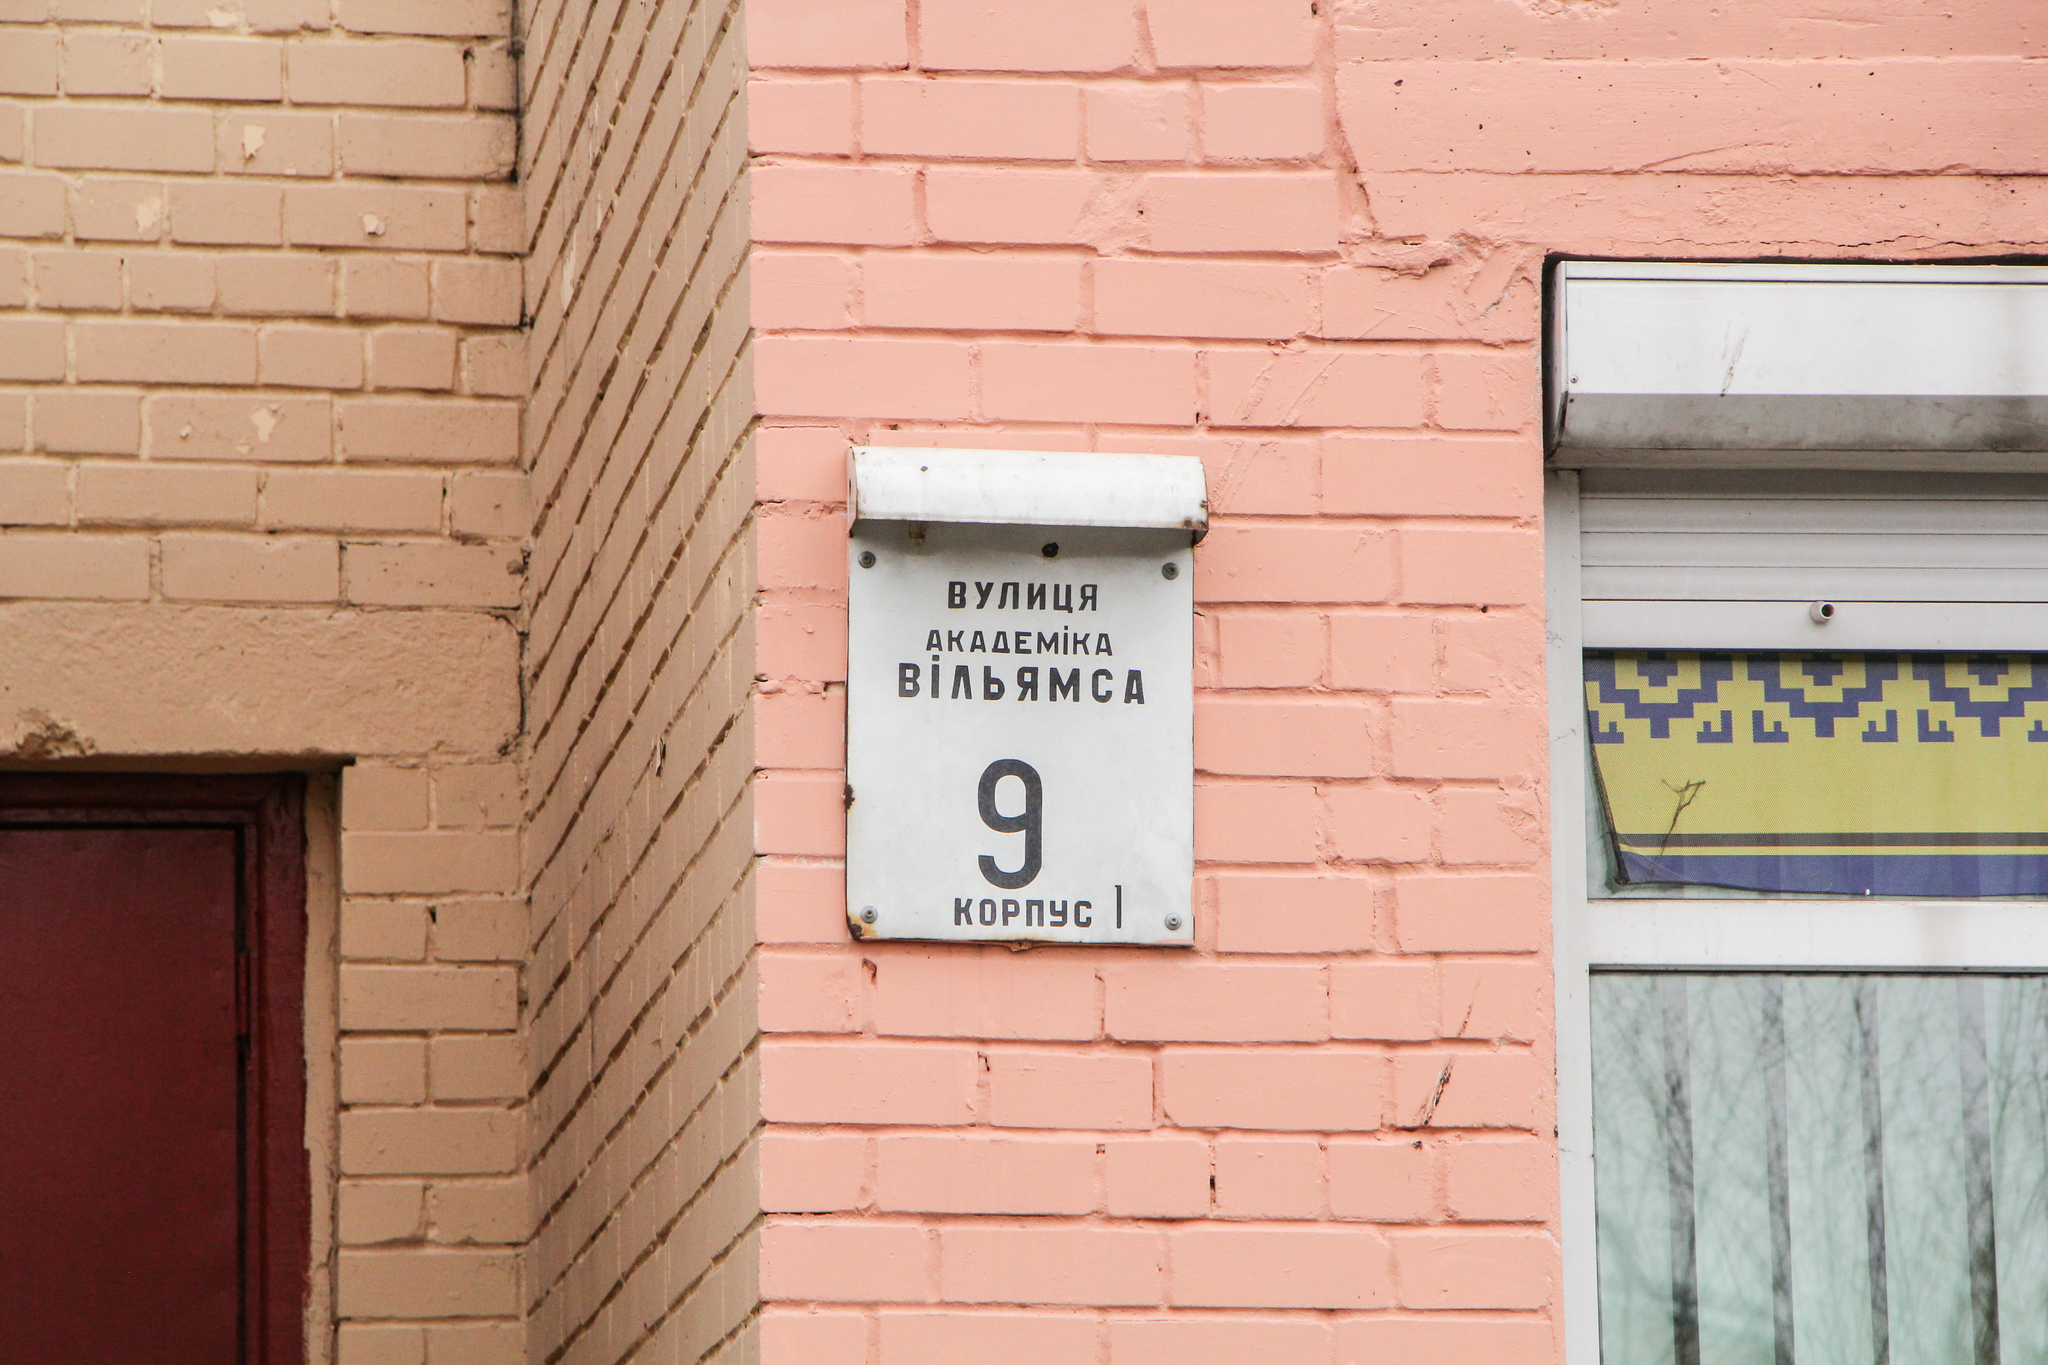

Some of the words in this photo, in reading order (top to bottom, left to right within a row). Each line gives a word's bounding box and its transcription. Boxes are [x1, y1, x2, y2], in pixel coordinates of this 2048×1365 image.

[947, 580, 1099, 614] ВУЛИЦЯ
[977, 758, 1043, 890] 9
[954, 897, 1093, 929] КОРПУС
[1113, 883, 1123, 930] 1
